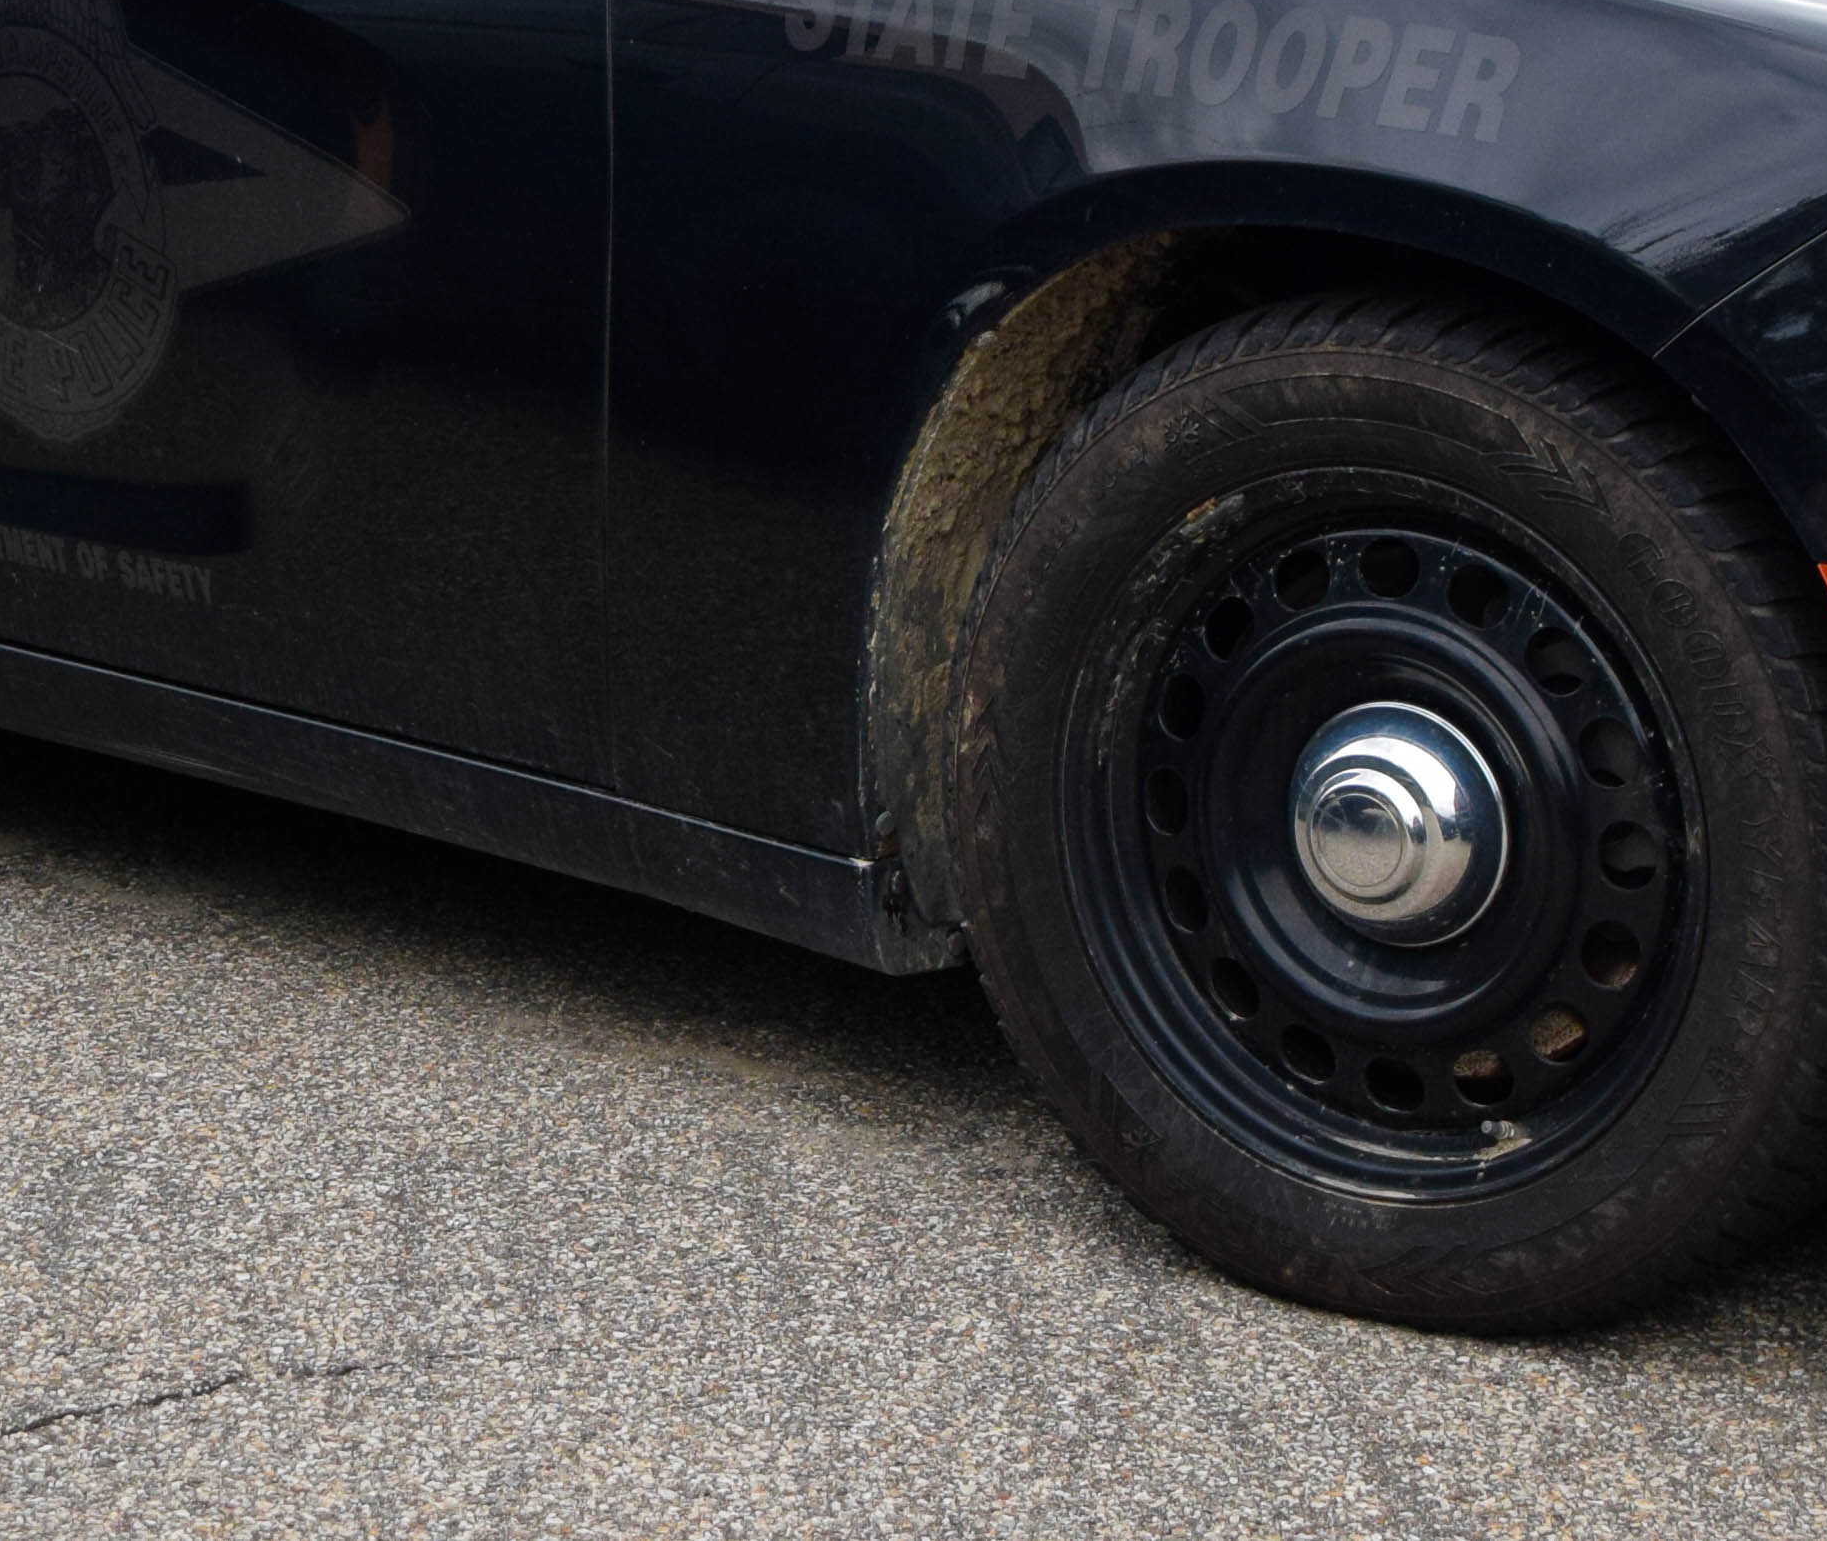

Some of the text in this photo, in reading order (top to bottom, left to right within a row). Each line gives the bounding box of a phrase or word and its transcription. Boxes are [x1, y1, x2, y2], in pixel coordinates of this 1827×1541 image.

[48, 243, 171, 404] POLICE
[76, 540, 110, 583] OF
[117, 549, 212, 605] SAFETY
